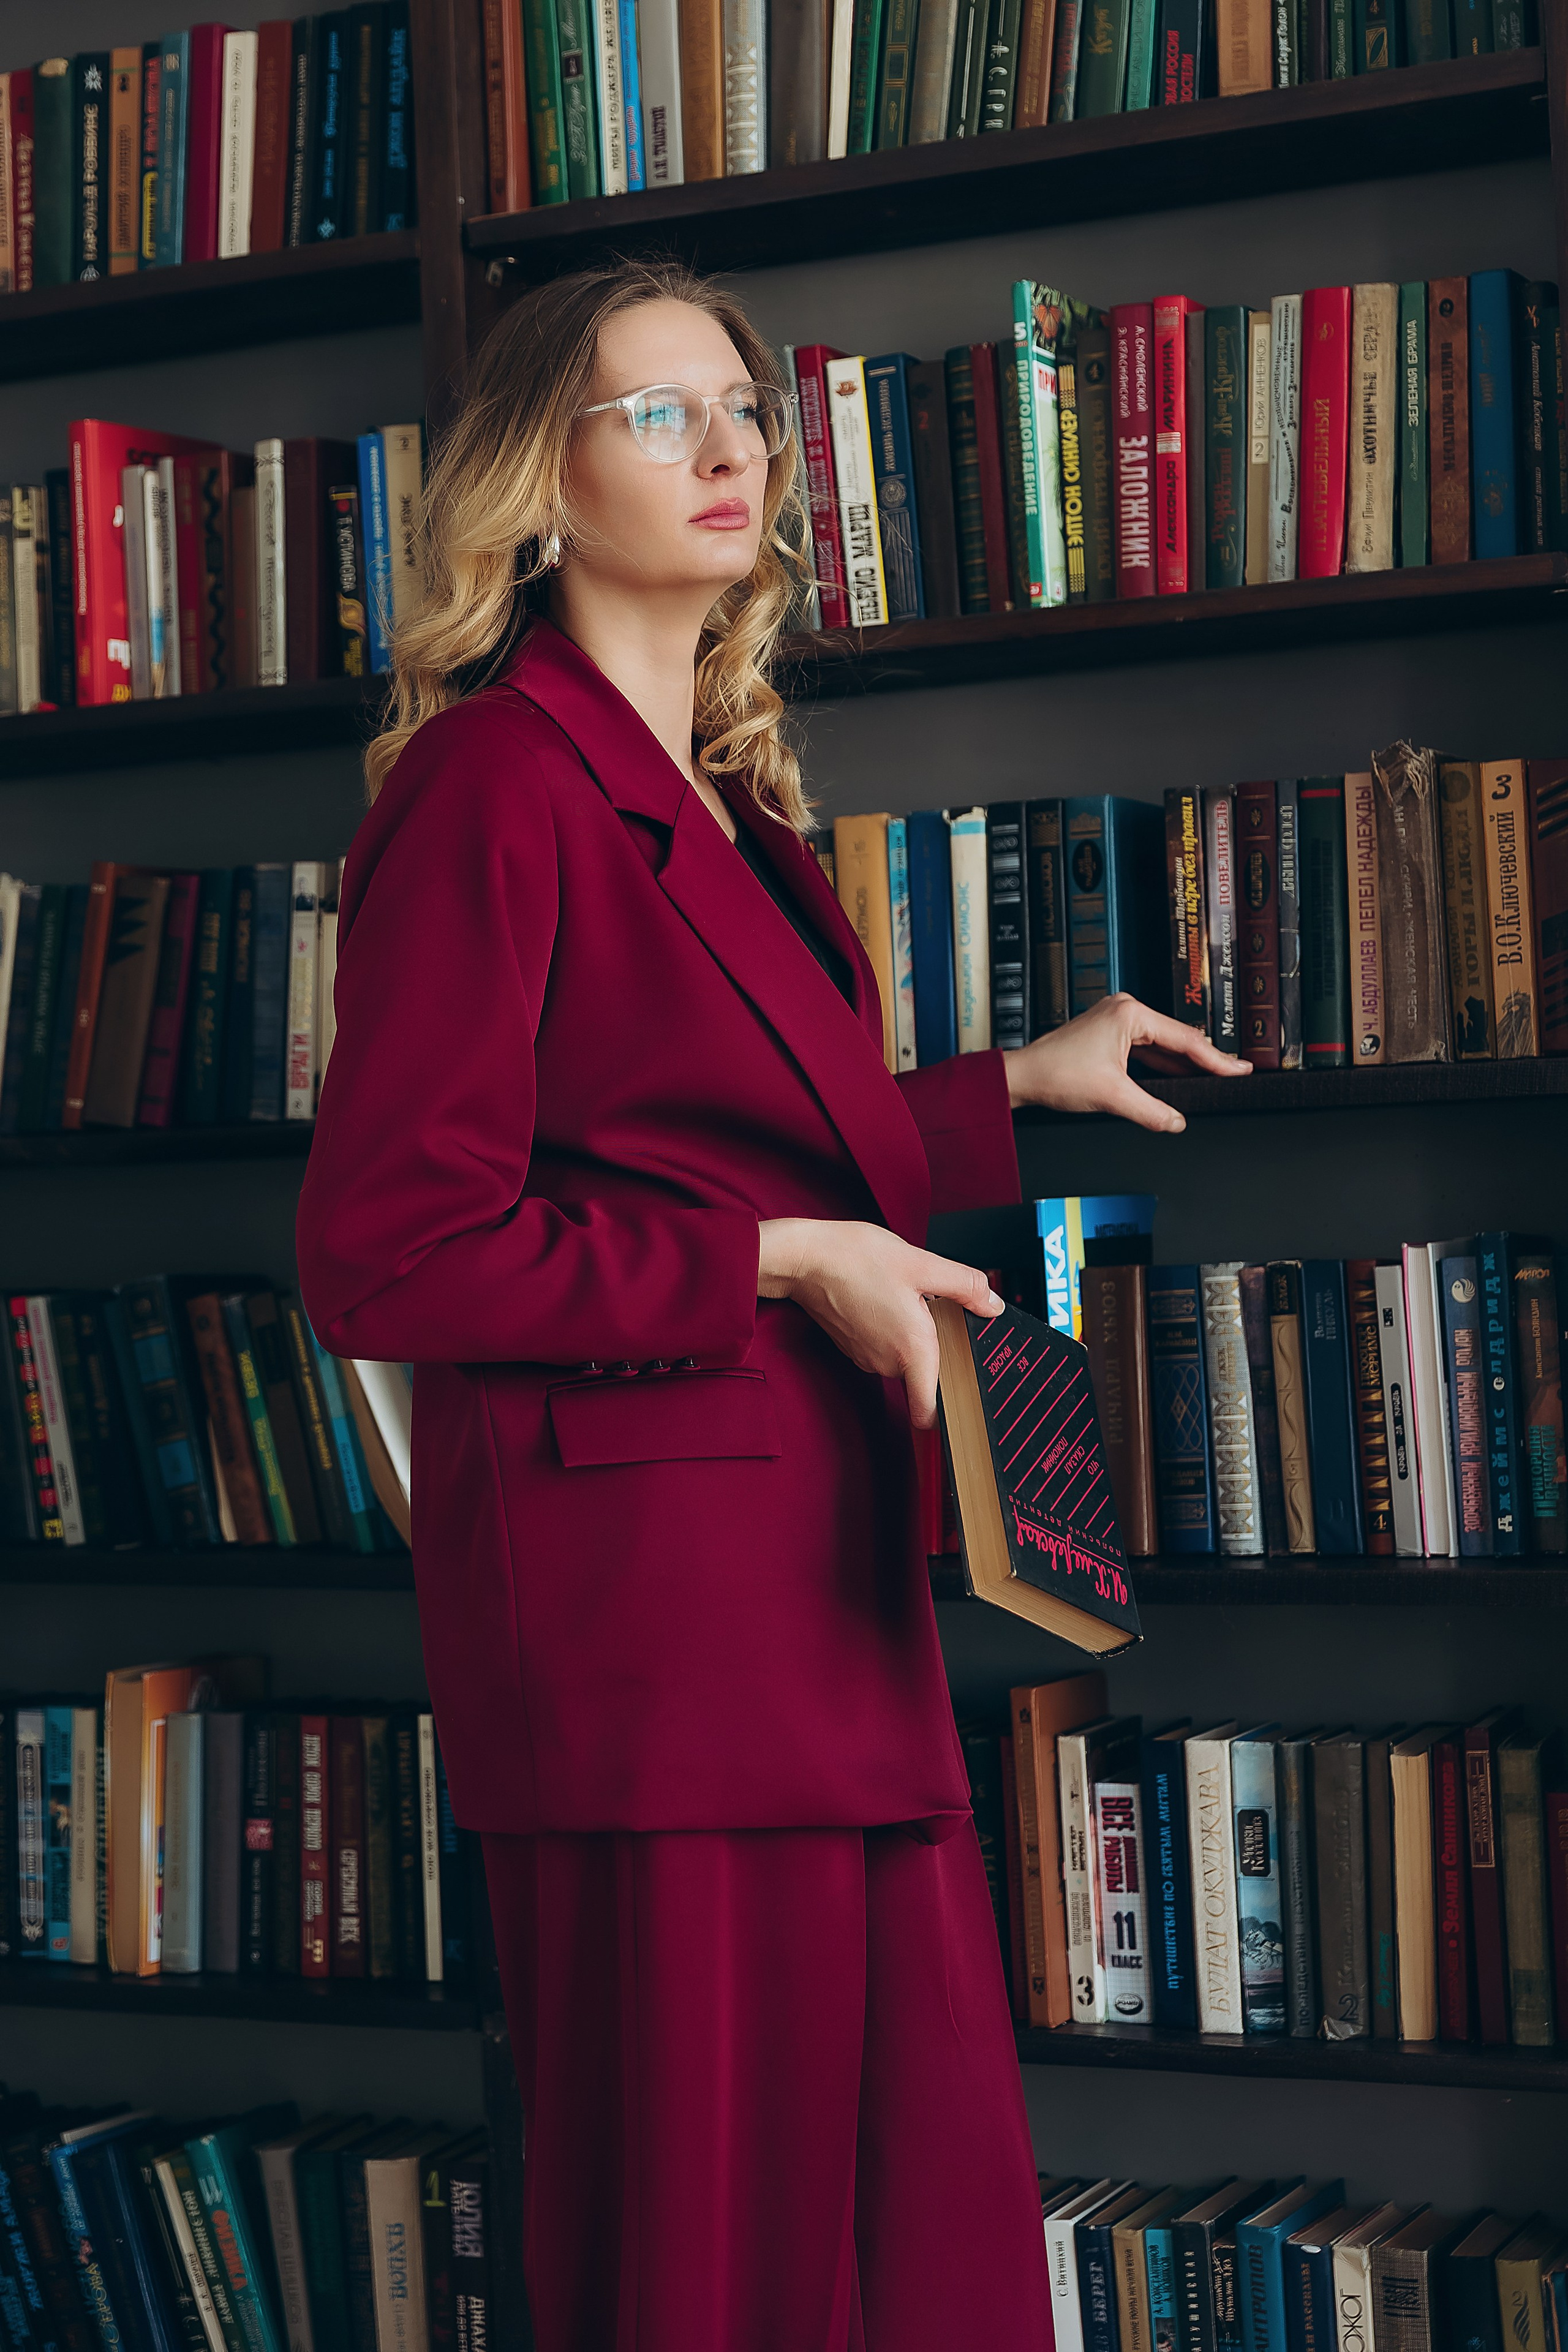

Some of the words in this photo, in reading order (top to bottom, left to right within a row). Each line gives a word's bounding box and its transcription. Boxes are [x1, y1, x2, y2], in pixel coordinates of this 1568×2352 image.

[1167, 30, 1180, 76] РОССИЯ
[1014, 322, 1032, 341] 5
[1406, 319, 1419, 365] БРАМА
[1162, 337, 1175, 431] МАРИНИНА
[1255, 337, 1267, 396] АННЕНКОВ
[1531, 341, 1542, 397] Анатолий
[1255, 401, 1266, 429] Юрий
[1362, 372, 1378, 465] ОХОТНИЧЬЕ
[1407, 368, 1419, 428] ЗЕЛЕНАЯ
[1016, 360, 1038, 516] ПРИРОДОВЕДЕНИЕ
[1059, 409, 1081, 482] СИНКЛЕР
[1066, 486, 1085, 547] ЭПТОН
[1118, 434, 1150, 570] ЗАЛОЖНИК
[1165, 460, 1179, 552] Александра
[1491, 774, 1512, 801] 3
[1180, 796, 1198, 853] правил
[1215, 799, 1231, 906] ПОВЕЛИТЕЛЬ
[1355, 785, 1376, 871] НАДЕЖДЫ
[1181, 853, 1196, 878] без
[1489, 810, 1523, 967] В.О.Ключевский
[1184, 878, 1199, 913] игре
[1188, 914, 1199, 924] в
[1358, 876, 1376, 933] ПЕПЕЛ
[1177, 921, 1188, 959] Галина
[1184, 927, 1202, 1006] Женщины
[1219, 914, 1234, 978] Джексон
[1403, 919, 1417, 984] ЖЕНСКАЯ
[1462, 911, 1480, 987] ГОРЫ
[1360, 939, 1381, 1016] АБДУЛЛАЕВ
[1221, 981, 1235, 1037] Мелани
[1363, 1017, 1378, 1031] Ч.
[1044, 1225, 1068, 1331] ИКА
[1100, 1280, 1118, 1344] ХЬЮЗ
[1324, 1288, 1337, 1340] ПИКУЛЬ
[1482, 1251, 1506, 1391] Олдридж
[990, 1344, 1012, 1376] КРАСНОЕ
[1017, 1355, 1030, 1371] ВСЕ
[1533, 1338, 1544, 1379] Константин
[1105, 1357, 1124, 1445] РИЧАРД
[1455, 1371, 1480, 1457] КРИМИНАЛЬНЫЙ
[1041, 1436, 1068, 1474] ПОКОЙНИК
[1066, 1444, 1086, 1476] СКАЗАЛ
[1087, 1460, 1101, 1476] ЧТО
[1491, 1407, 1513, 1533] Джеймс
[1540, 1425, 1560, 1499] ВЕЧНОСТИ
[1100, 1796, 1136, 1831] ВСЕ
[1156, 1773, 1170, 1822] МЕСТАМ
[1440, 1761, 1457, 1866] Санникова
[1102, 1835, 1123, 1893] РАБОТЫ
[1159, 1825, 1175, 1877] СВЯТЫМ
[1196, 1762, 1227, 1918] ОКУДЖАВА
[1162, 1881, 1176, 1902] ПО
[1442, 1871, 1460, 1934] Земля
[1113, 1910, 1137, 1951] 11
[1163, 1905, 1185, 1989] ПУТЕШЕСТВИЕ
[1204, 1921, 1231, 2016] БУЛАТ
[1338, 1993, 1359, 2021] 2
[464, 2181, 484, 2258] ЮЛИЯ
[1054, 2240, 1068, 2286] Витицкий
[1056, 2287, 1069, 2297] С.
[1088, 2261, 1108, 2324] БЕРЕГ
[467, 2295, 486, 2352] ДЖАХА
[1183, 2250, 1202, 2352] АТУШИНСКАЯ
[1300, 2263, 1314, 2331] РАССКАЗЫ
